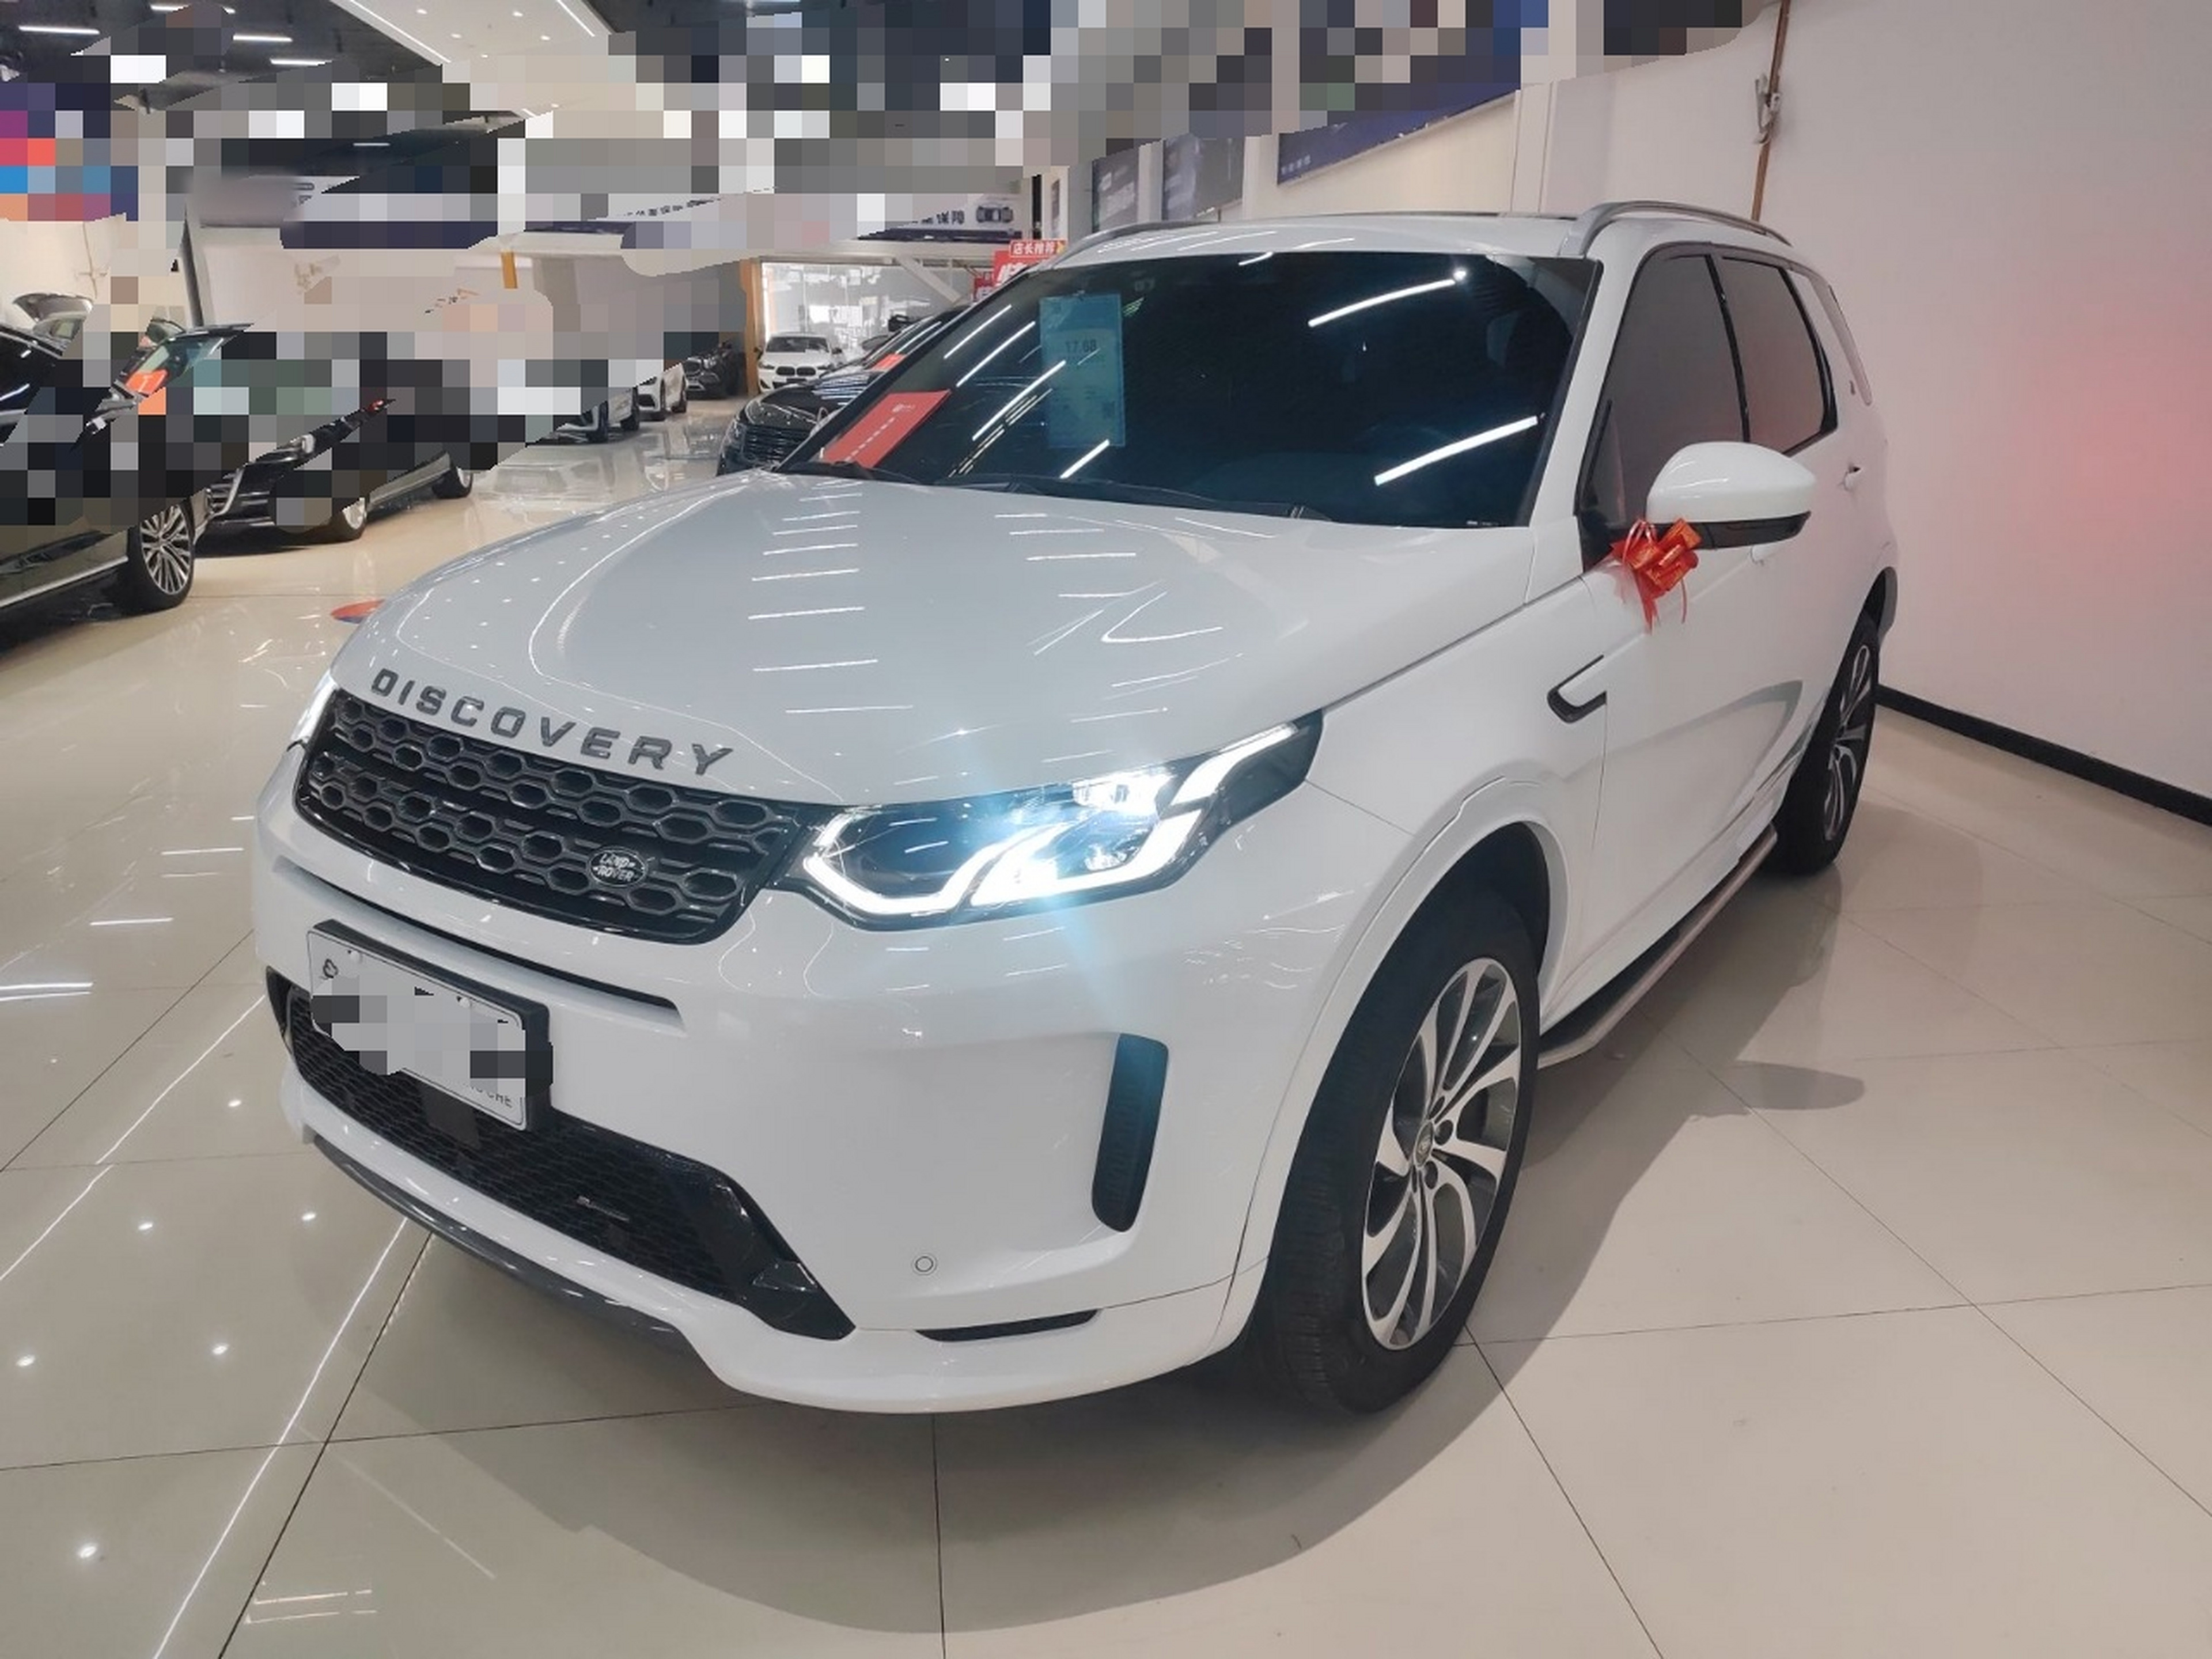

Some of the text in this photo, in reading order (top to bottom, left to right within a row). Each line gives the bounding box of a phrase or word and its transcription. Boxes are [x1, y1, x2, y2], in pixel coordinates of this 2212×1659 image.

[1013, 242, 1055, 255] 店长推荐
[371, 668, 733, 775] DISCOVERY
[599, 854, 630, 868] LAND
[597, 865, 634, 882] ROVER
